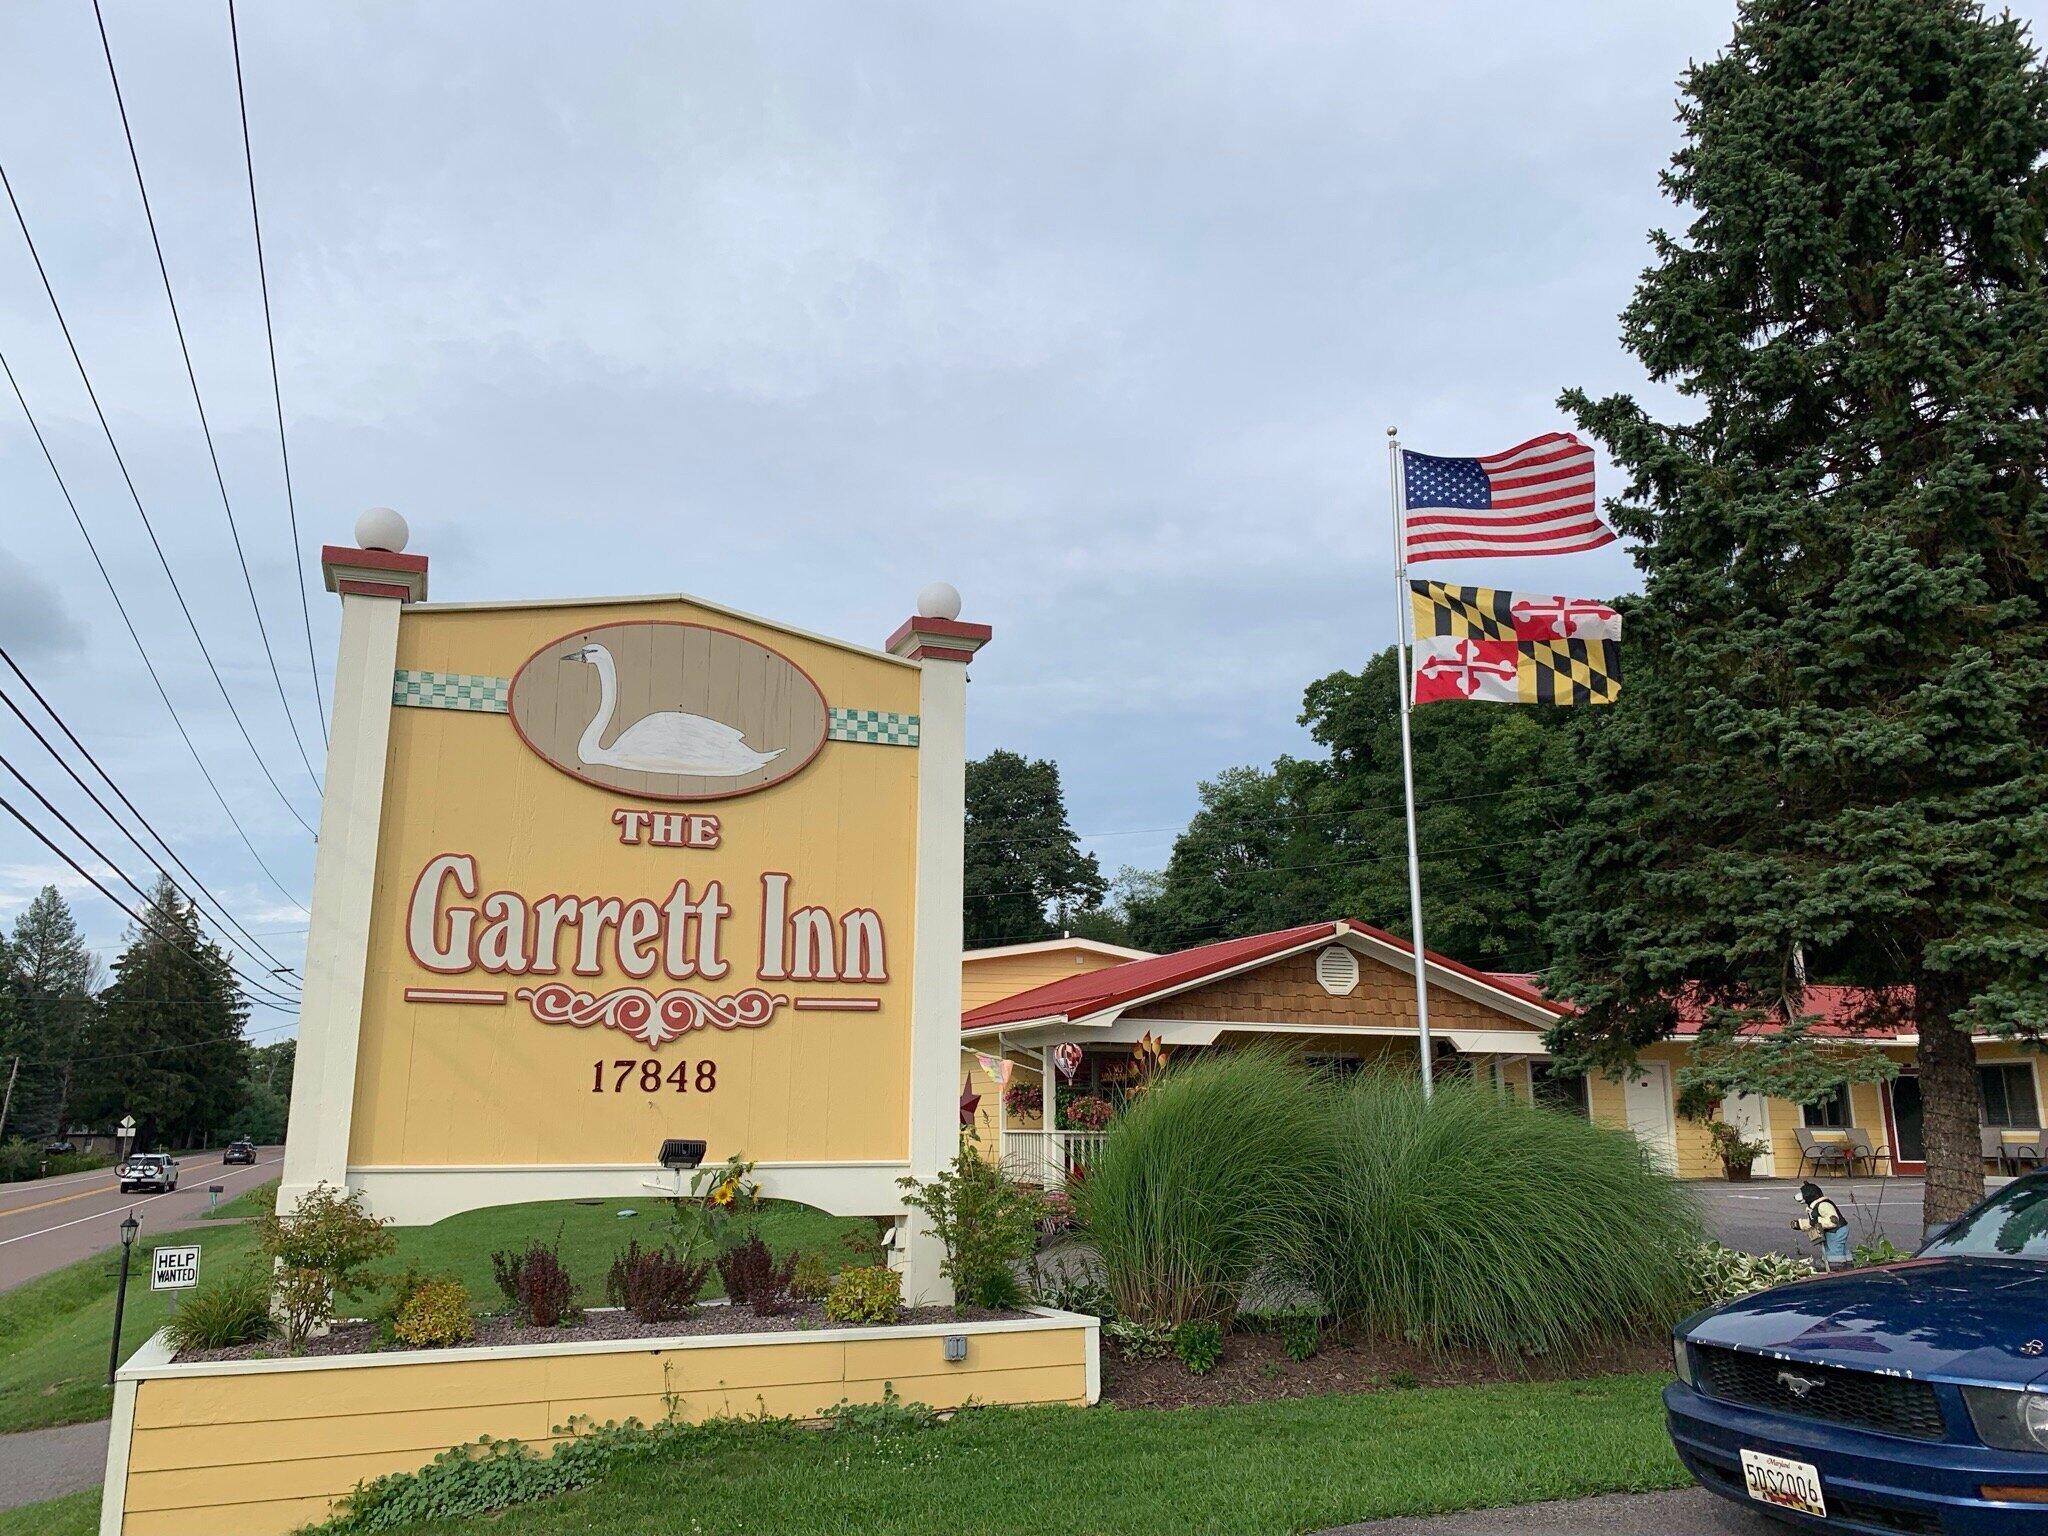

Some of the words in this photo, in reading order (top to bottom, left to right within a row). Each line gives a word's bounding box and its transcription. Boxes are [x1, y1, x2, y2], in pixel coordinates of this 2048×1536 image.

[612, 809, 721, 849] THE
[406, 853, 731, 980] Garrett
[756, 872, 889, 984] Inn
[591, 1059, 718, 1093] 17848
[157, 1268, 195, 1283] WANTED
[159, 1253, 195, 1268] HELP
[1767, 1458, 1790, 1469] Maryland
[1746, 1463, 1818, 1502] 5DS2006
